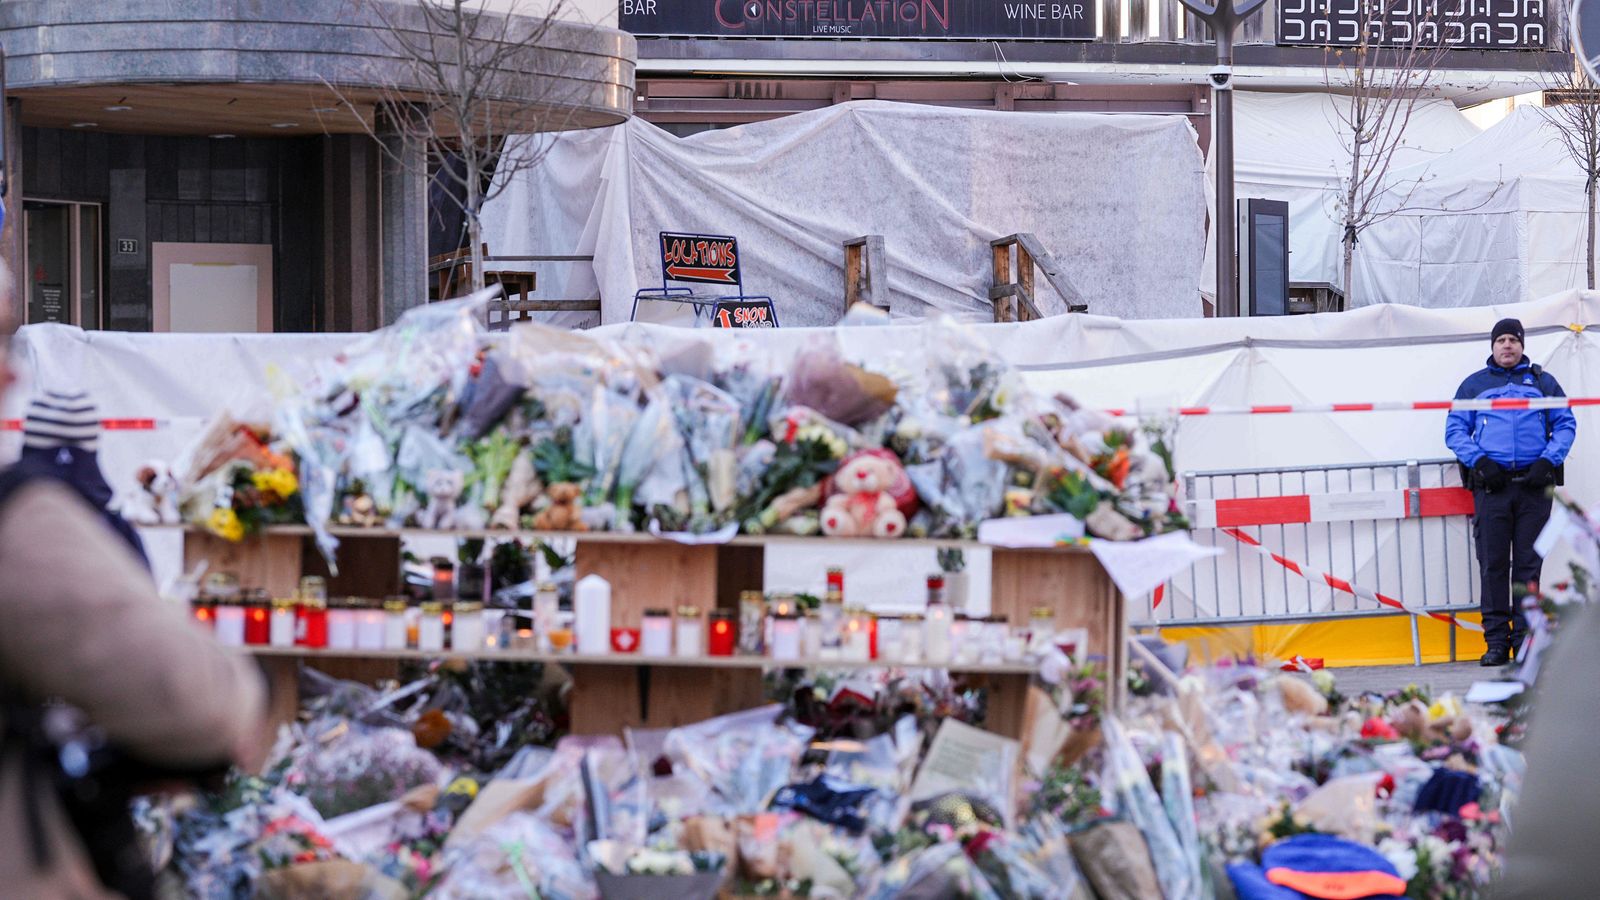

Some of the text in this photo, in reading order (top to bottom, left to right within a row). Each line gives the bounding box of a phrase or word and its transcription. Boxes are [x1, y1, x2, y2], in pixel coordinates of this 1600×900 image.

[623, 0, 657, 15] BAR
[714, 0, 949, 30] CONSTELLATION
[1004, 4, 1084, 20] WINE BAR
[812, 25, 852, 34] LIVE MUSIC
[122, 241, 134, 252] 33
[663, 238, 736, 267] LOCATIONS
[734, 306, 768, 324] SNOW
